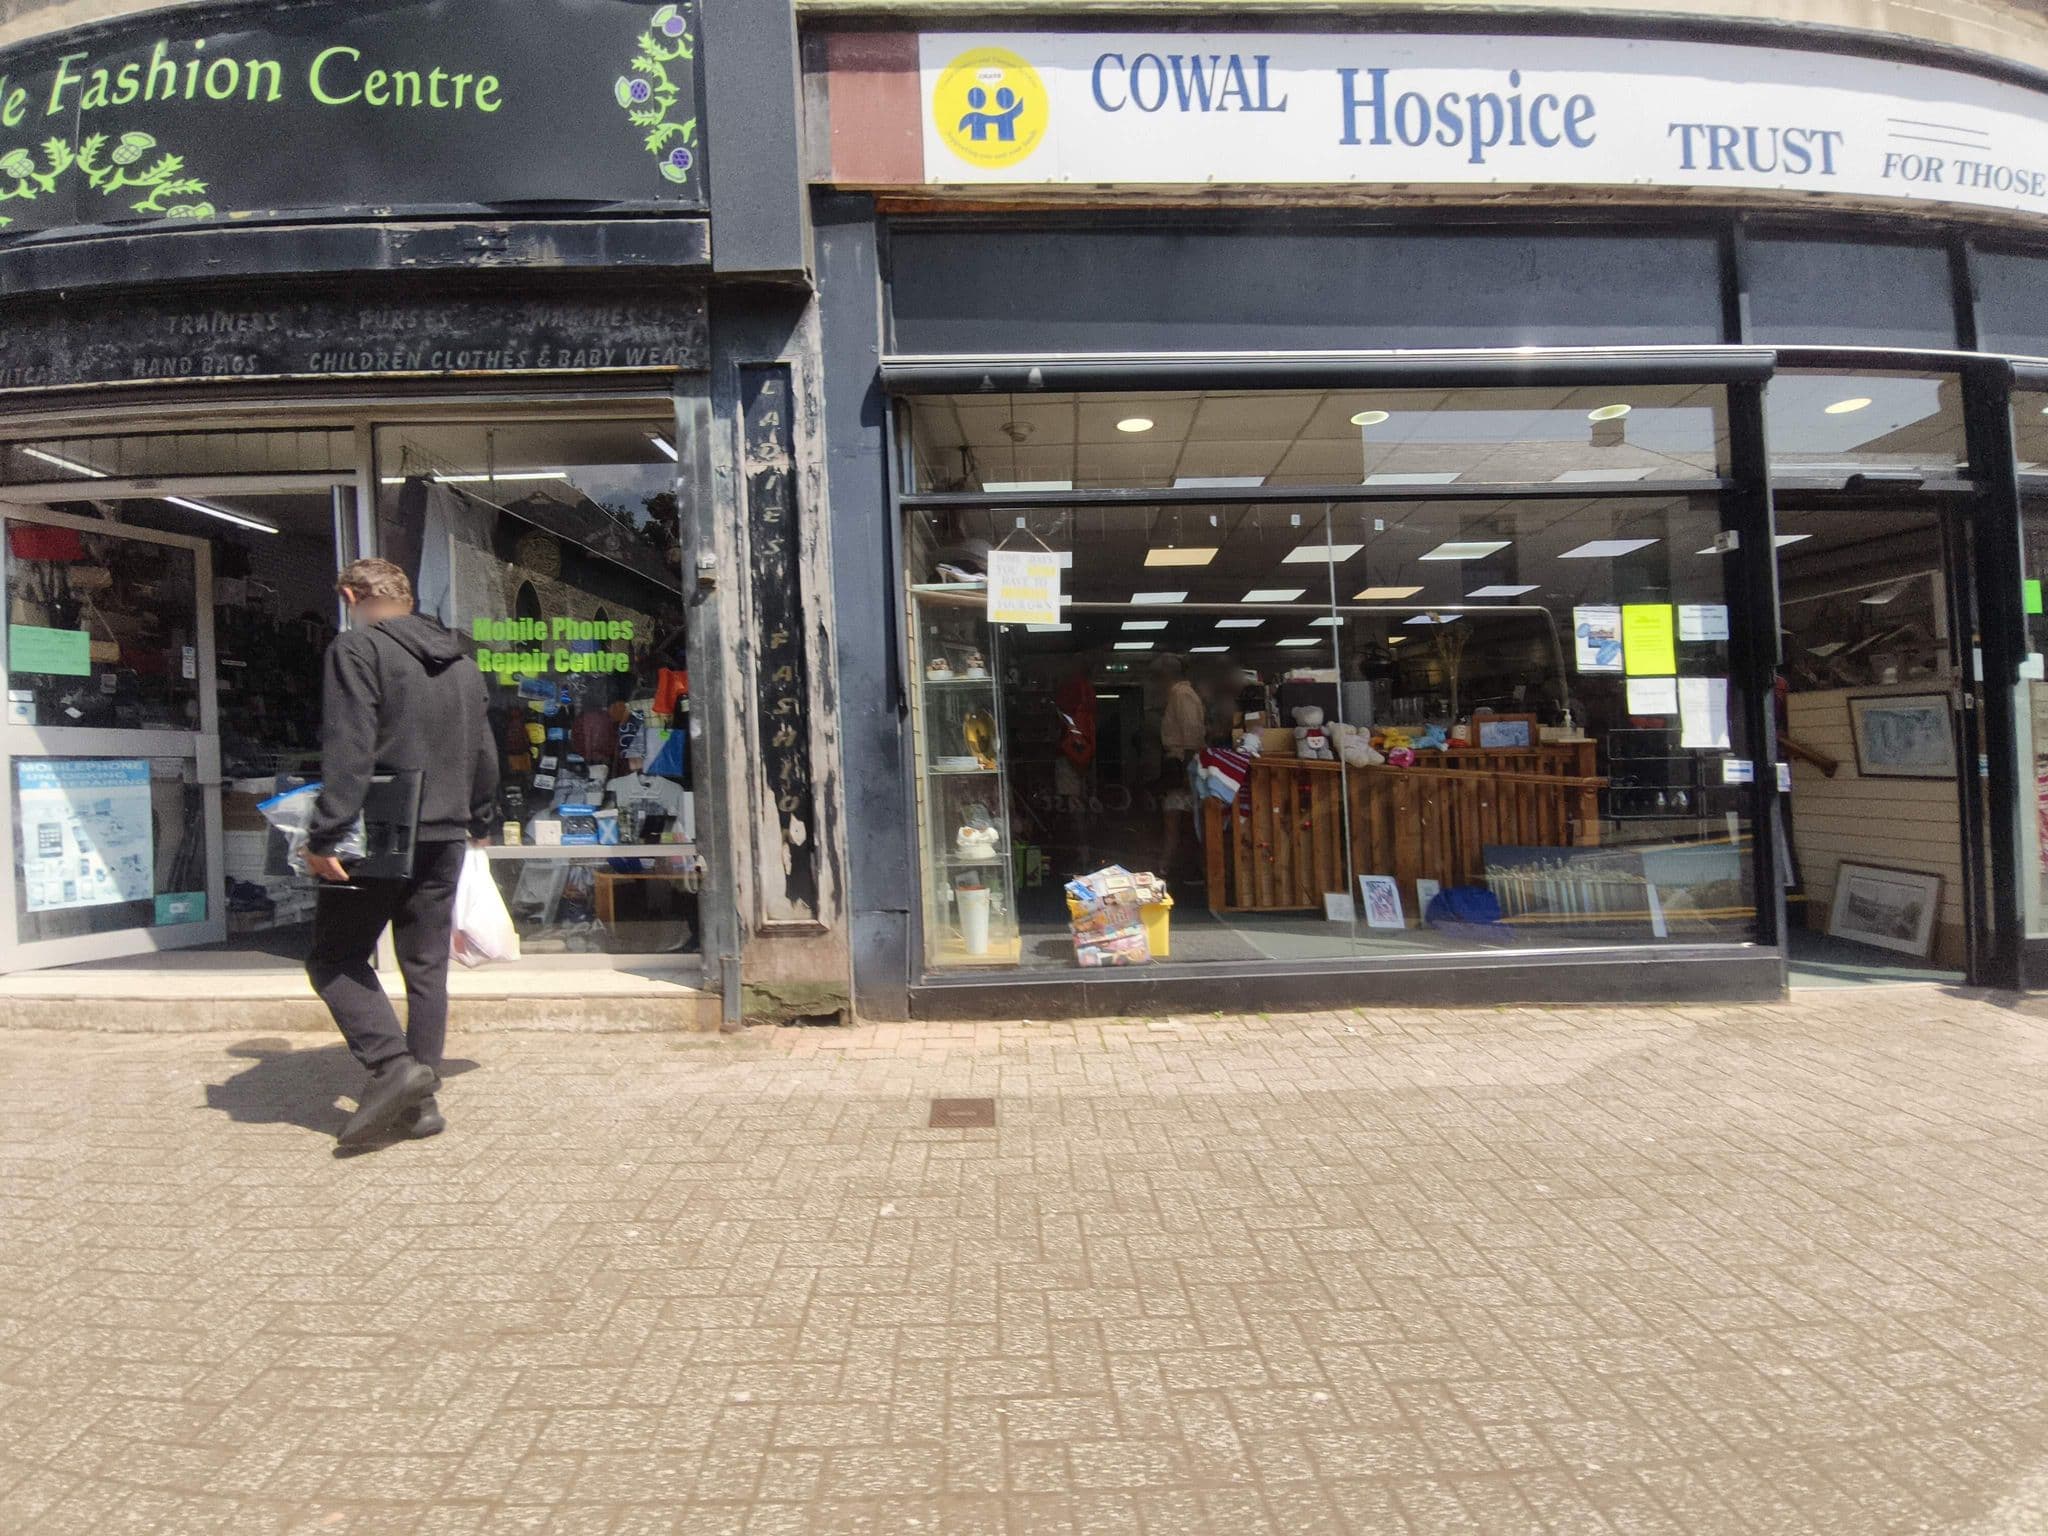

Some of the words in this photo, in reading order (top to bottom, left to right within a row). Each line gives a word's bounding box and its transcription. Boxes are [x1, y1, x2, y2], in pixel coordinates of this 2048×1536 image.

[46, 38, 283, 116] Fashion
[309, 45, 503, 112] Centre
[1090, 52, 1289, 113] COWAL
[1337, 67, 1598, 165] Hospice
[1667, 121, 1845, 177] TRUST
[1880, 151, 1945, 184] FOR
[1951, 158, 2047, 198] THOSE
[201, 353, 258, 375] BAGS
[308, 349, 422, 372] CHILDREN
[430, 348, 528, 370] CLOTHES
[536, 346, 552, 368] &
[557, 347, 616, 368] BABY
[625, 346, 692, 367] WEAR
[472, 617, 549, 641] Mobile
[552, 617, 635, 640] Phones
[476, 648, 550, 674] Repair
[554, 648, 630, 673] Centre
